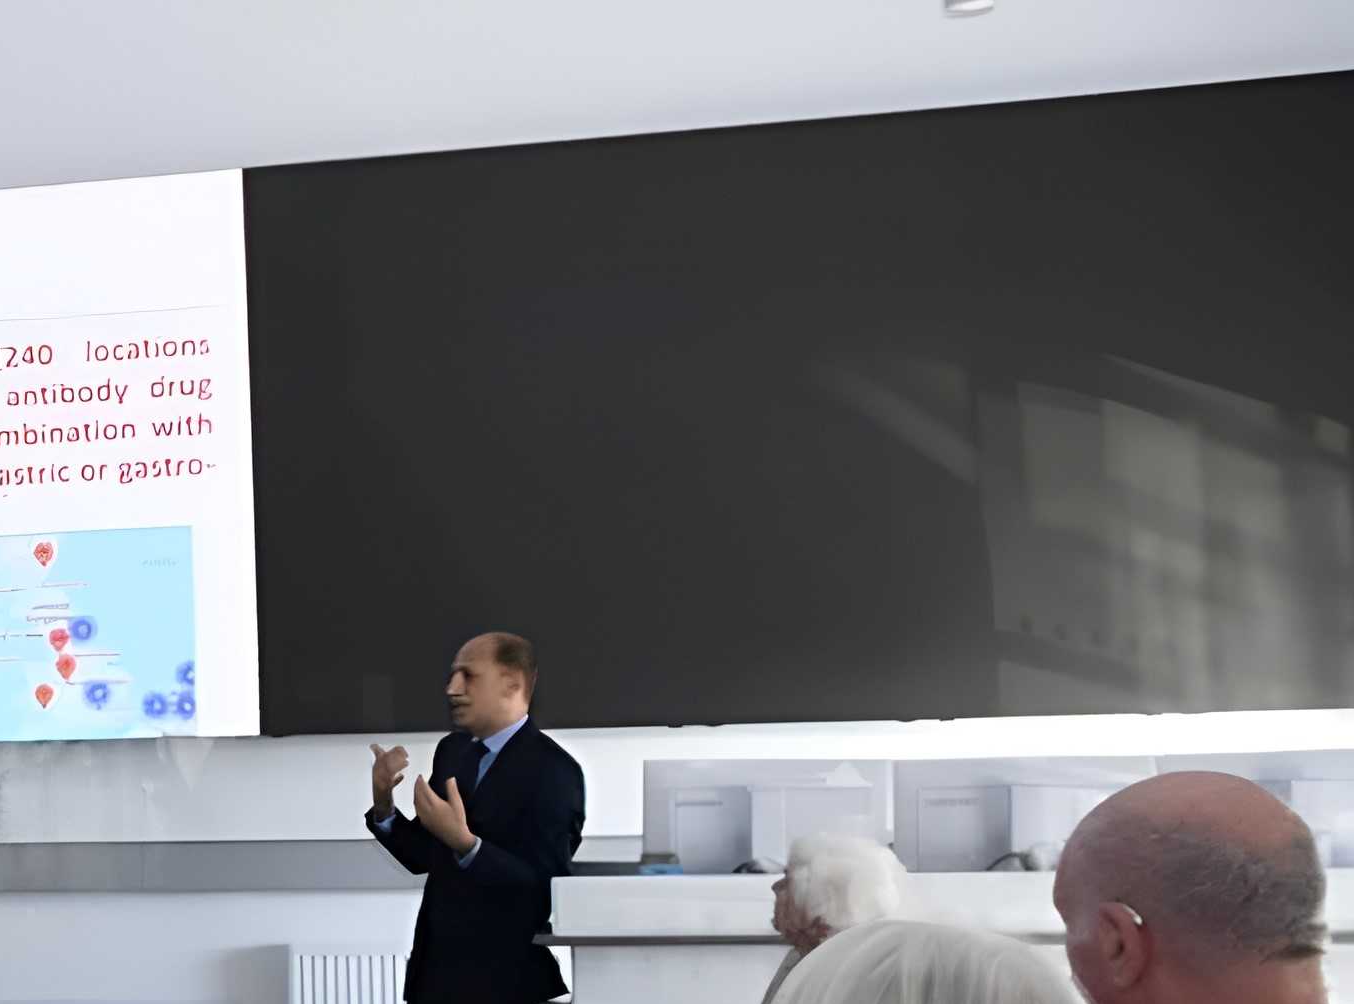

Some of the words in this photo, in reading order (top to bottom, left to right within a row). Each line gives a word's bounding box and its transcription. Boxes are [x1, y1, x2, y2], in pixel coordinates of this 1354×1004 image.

[86, 338, 210, 362] locations
[7, 379, 128, 406] antibody
[151, 376, 212, 400] drug
[152, 413, 213, 437] with
[81, 464, 107, 482] or
